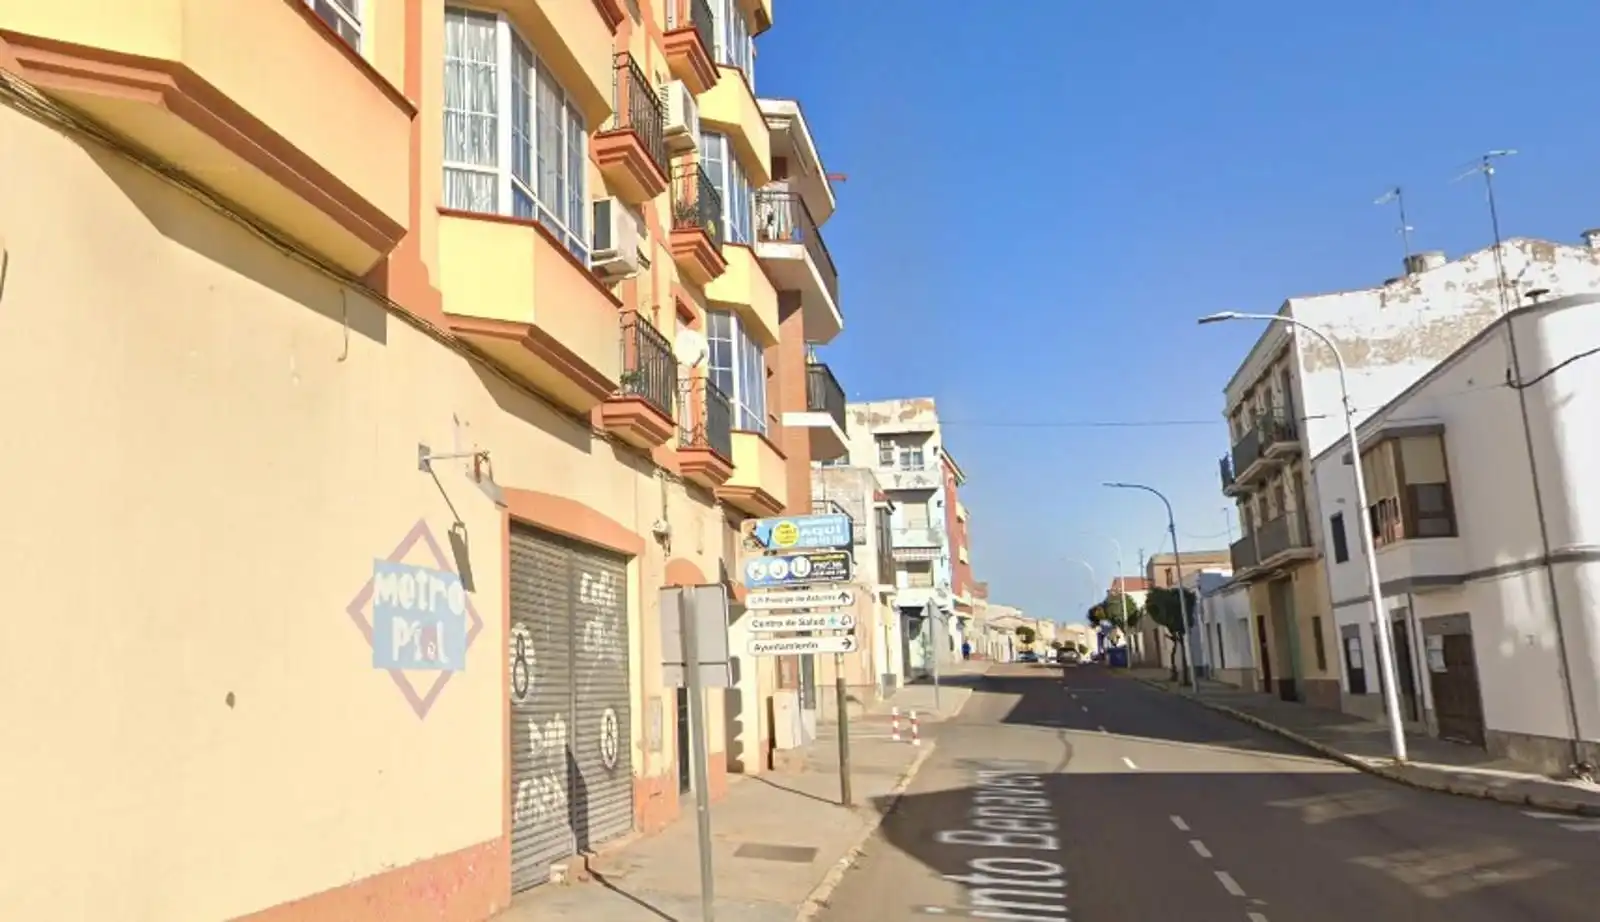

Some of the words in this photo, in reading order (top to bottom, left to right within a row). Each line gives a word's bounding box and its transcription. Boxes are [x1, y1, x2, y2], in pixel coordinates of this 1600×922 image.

[752, 619, 783, 628] Centro
[798, 617, 825, 626] Salud
[754, 641, 818, 652] Ayuntamiento
